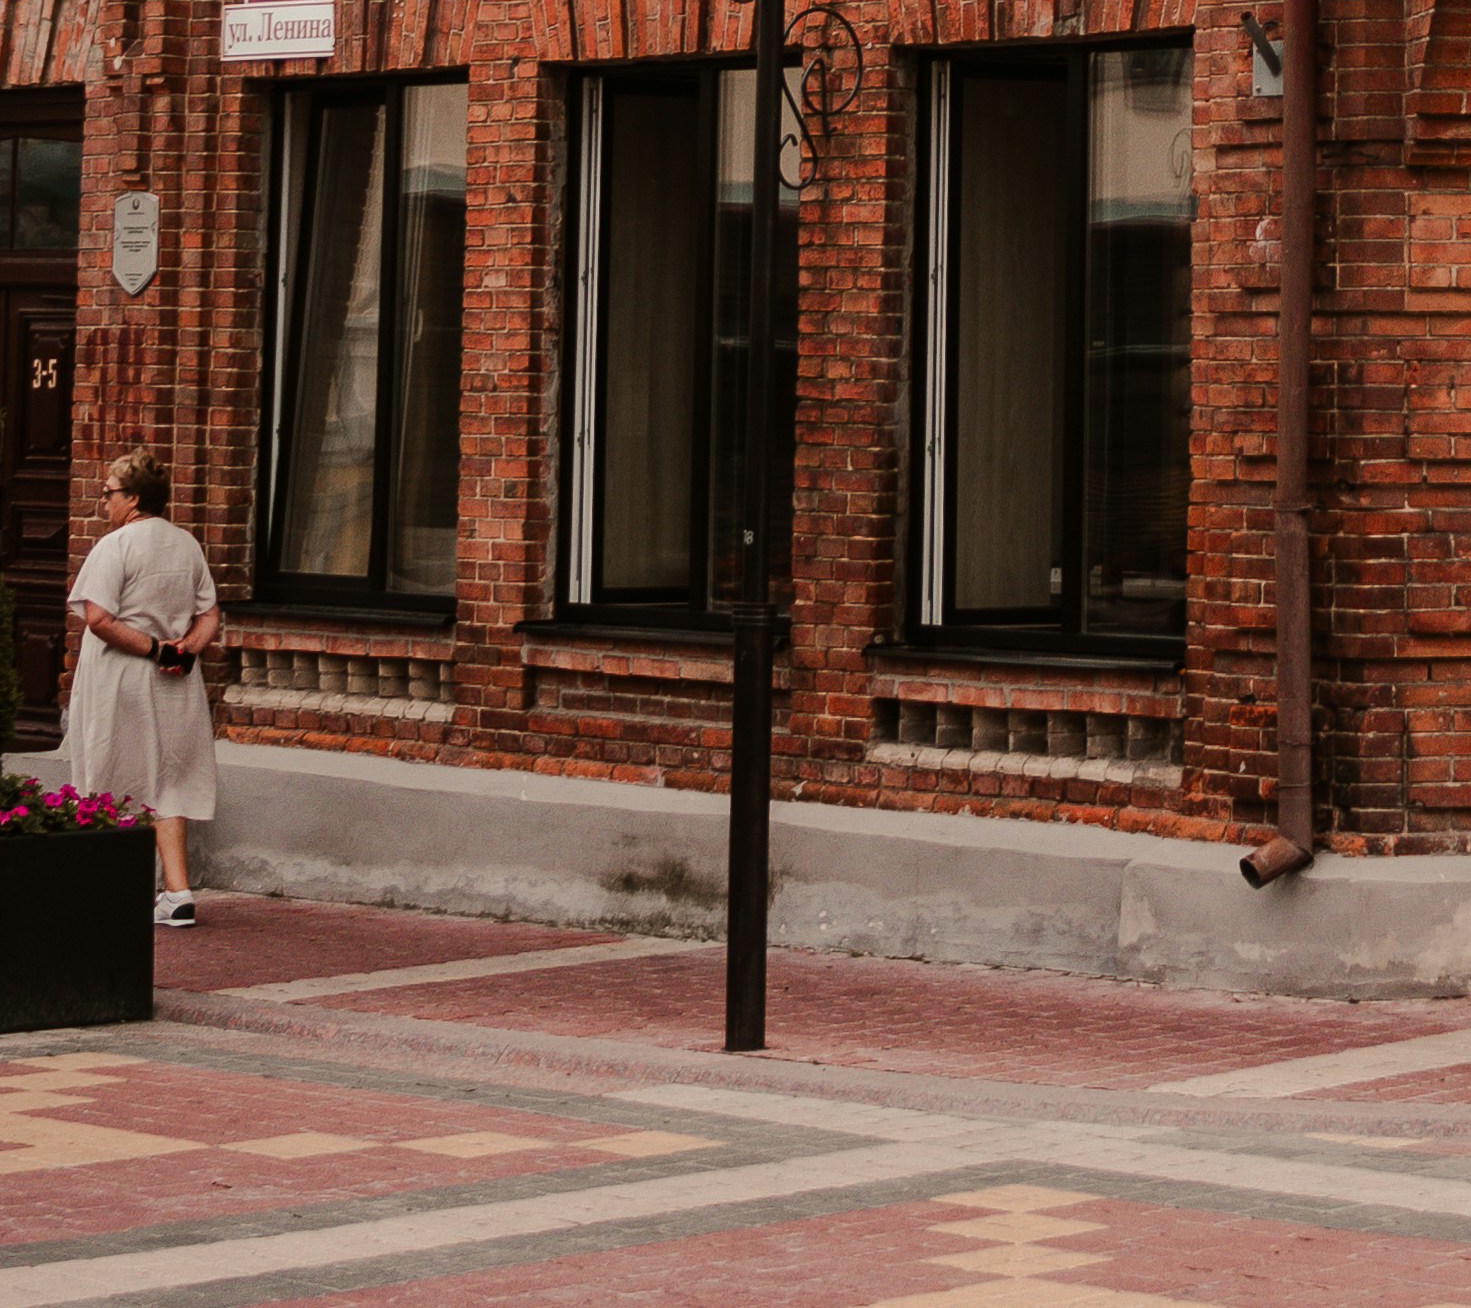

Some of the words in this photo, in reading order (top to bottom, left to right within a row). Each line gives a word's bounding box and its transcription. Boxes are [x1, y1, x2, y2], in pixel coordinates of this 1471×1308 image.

[228, 23, 253, 50] ул.
[258, 12, 332, 42] Ленина
[32, 358, 57, 389] 3-5
